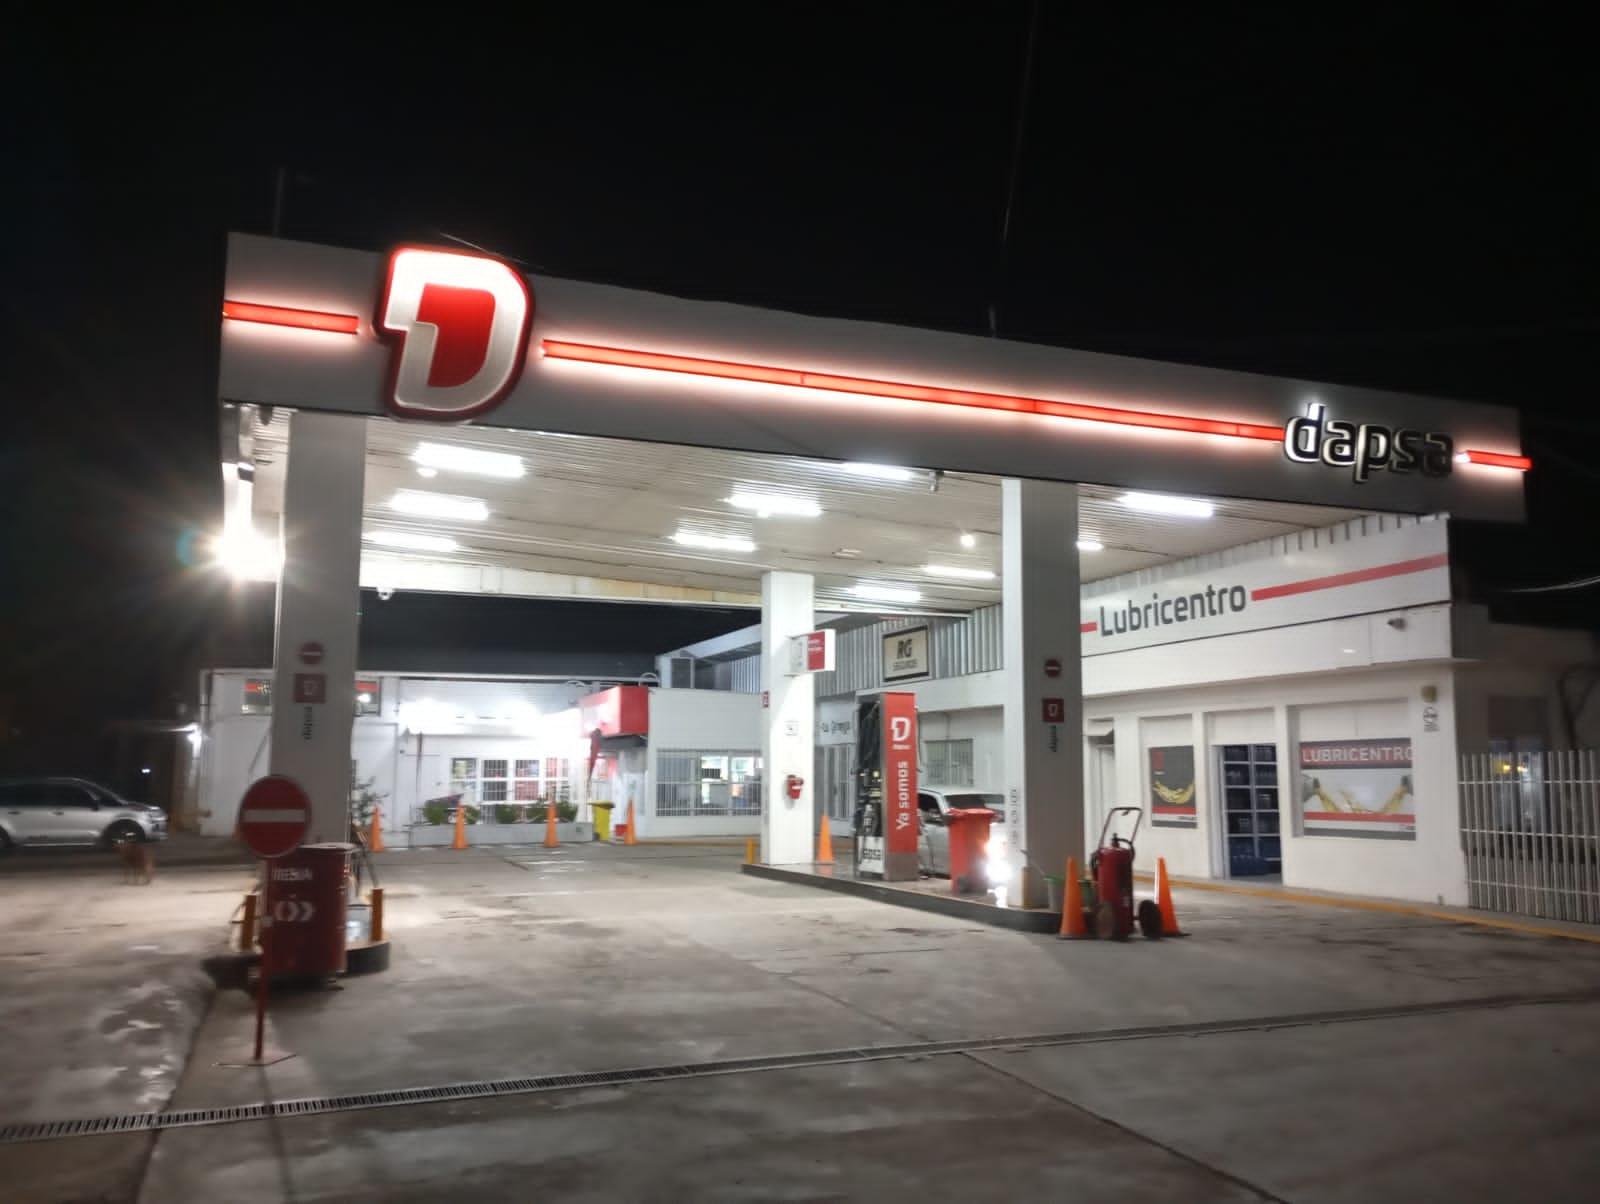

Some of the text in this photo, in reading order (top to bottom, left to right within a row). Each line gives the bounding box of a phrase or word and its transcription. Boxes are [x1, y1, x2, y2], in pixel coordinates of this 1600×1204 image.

[384, 248, 527, 412] D
[1283, 402, 1454, 483] dapsa
[1100, 584, 1247, 637] Lubricentro
[897, 761, 910, 809] somos
[896, 812, 910, 830] Ya
